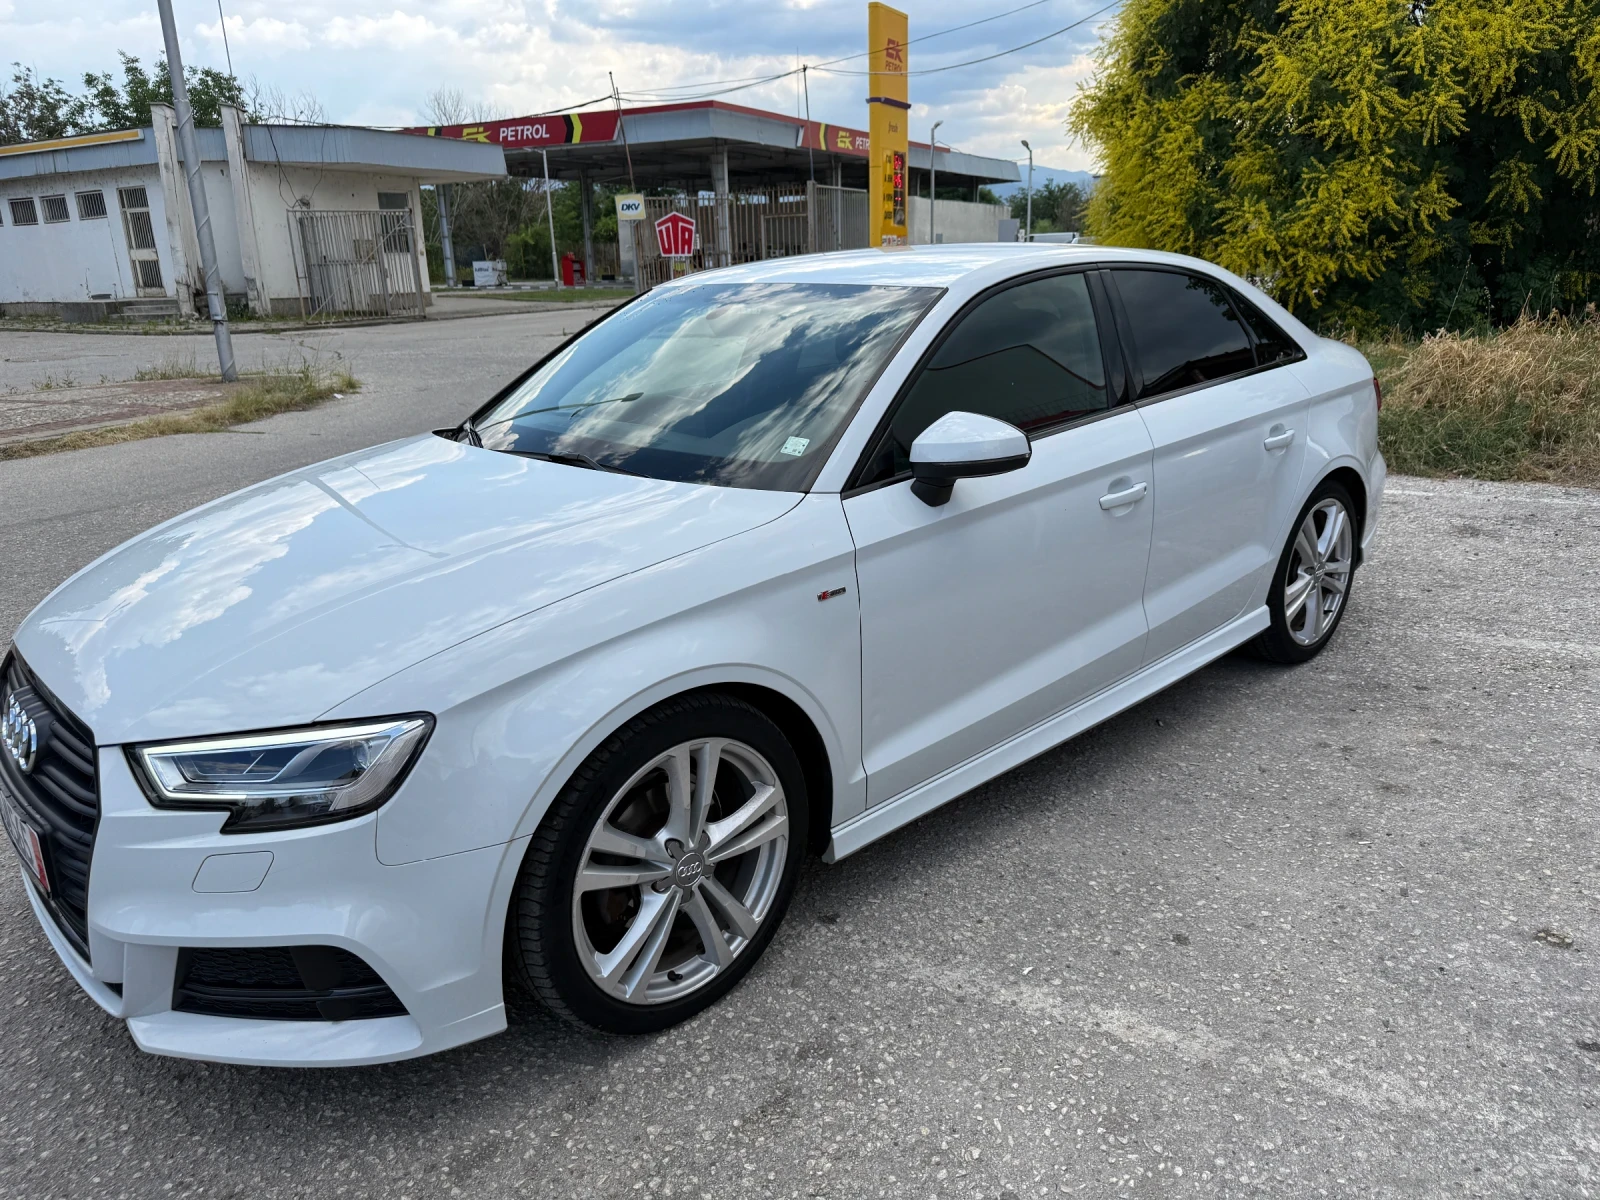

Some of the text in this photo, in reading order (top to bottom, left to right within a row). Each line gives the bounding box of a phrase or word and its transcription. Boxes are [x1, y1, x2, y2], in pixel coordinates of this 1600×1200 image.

[500, 124, 549, 141] PETROL
[621, 203, 640, 211] DKV
[656, 212, 695, 256] UTA
